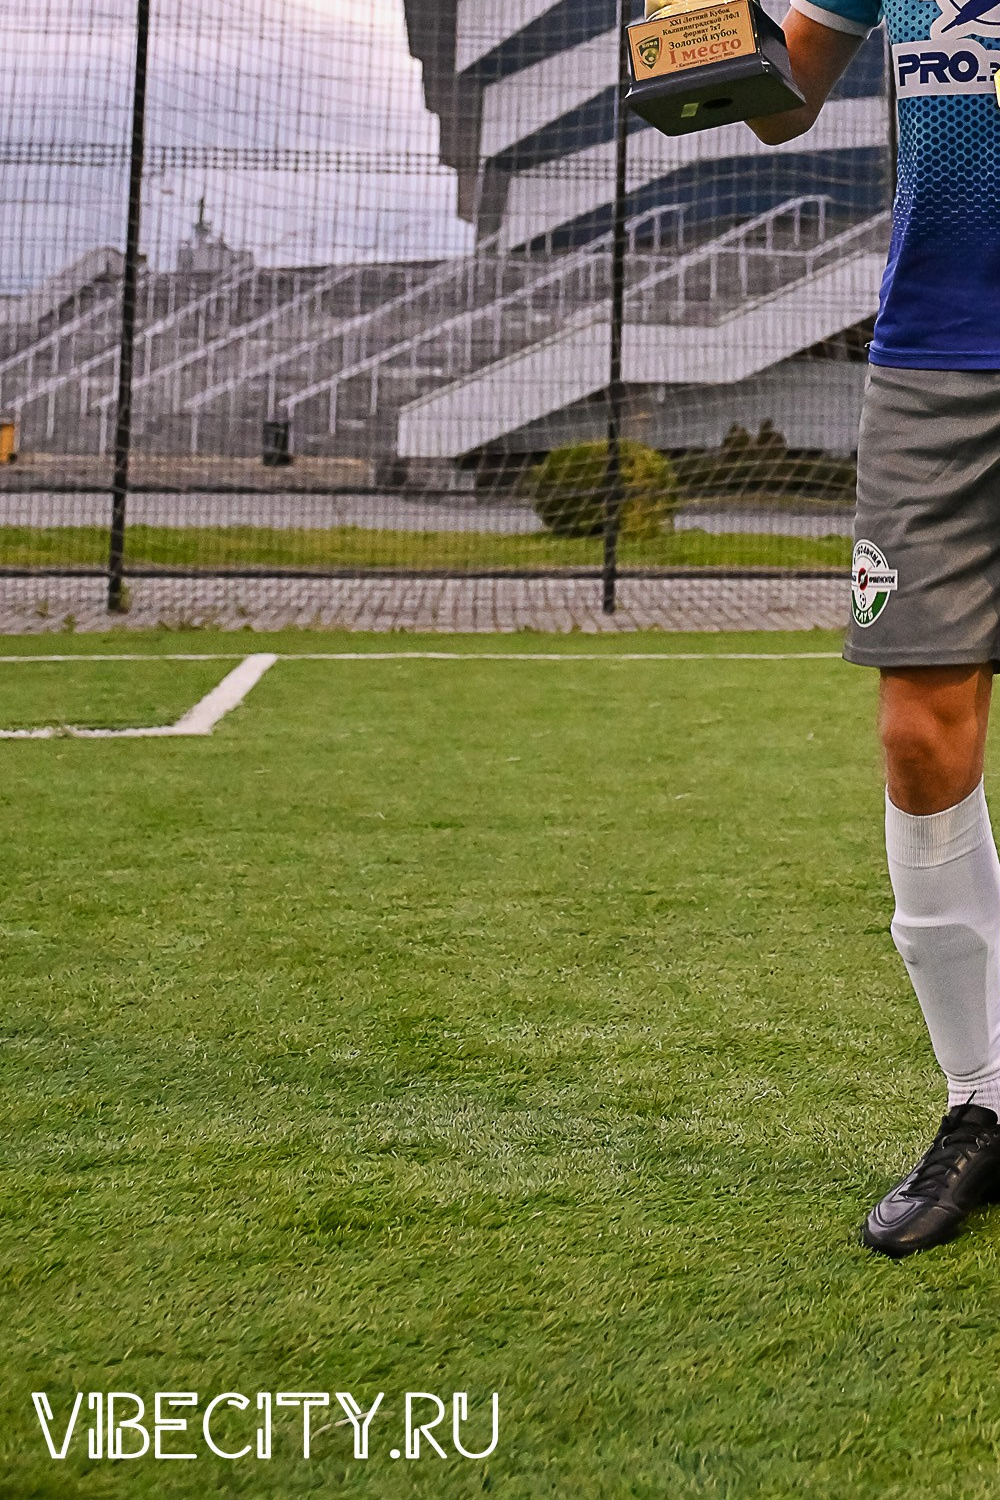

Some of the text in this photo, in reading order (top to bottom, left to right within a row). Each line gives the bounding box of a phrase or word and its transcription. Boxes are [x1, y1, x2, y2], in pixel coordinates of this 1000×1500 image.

[709, 7, 731, 18] Кубок
[723, 11, 740, 21] ЛФЛ
[668, 28, 738, 50] Золотой кубок
[683, 27, 708, 39] формат
[681, 38, 742, 61] место
